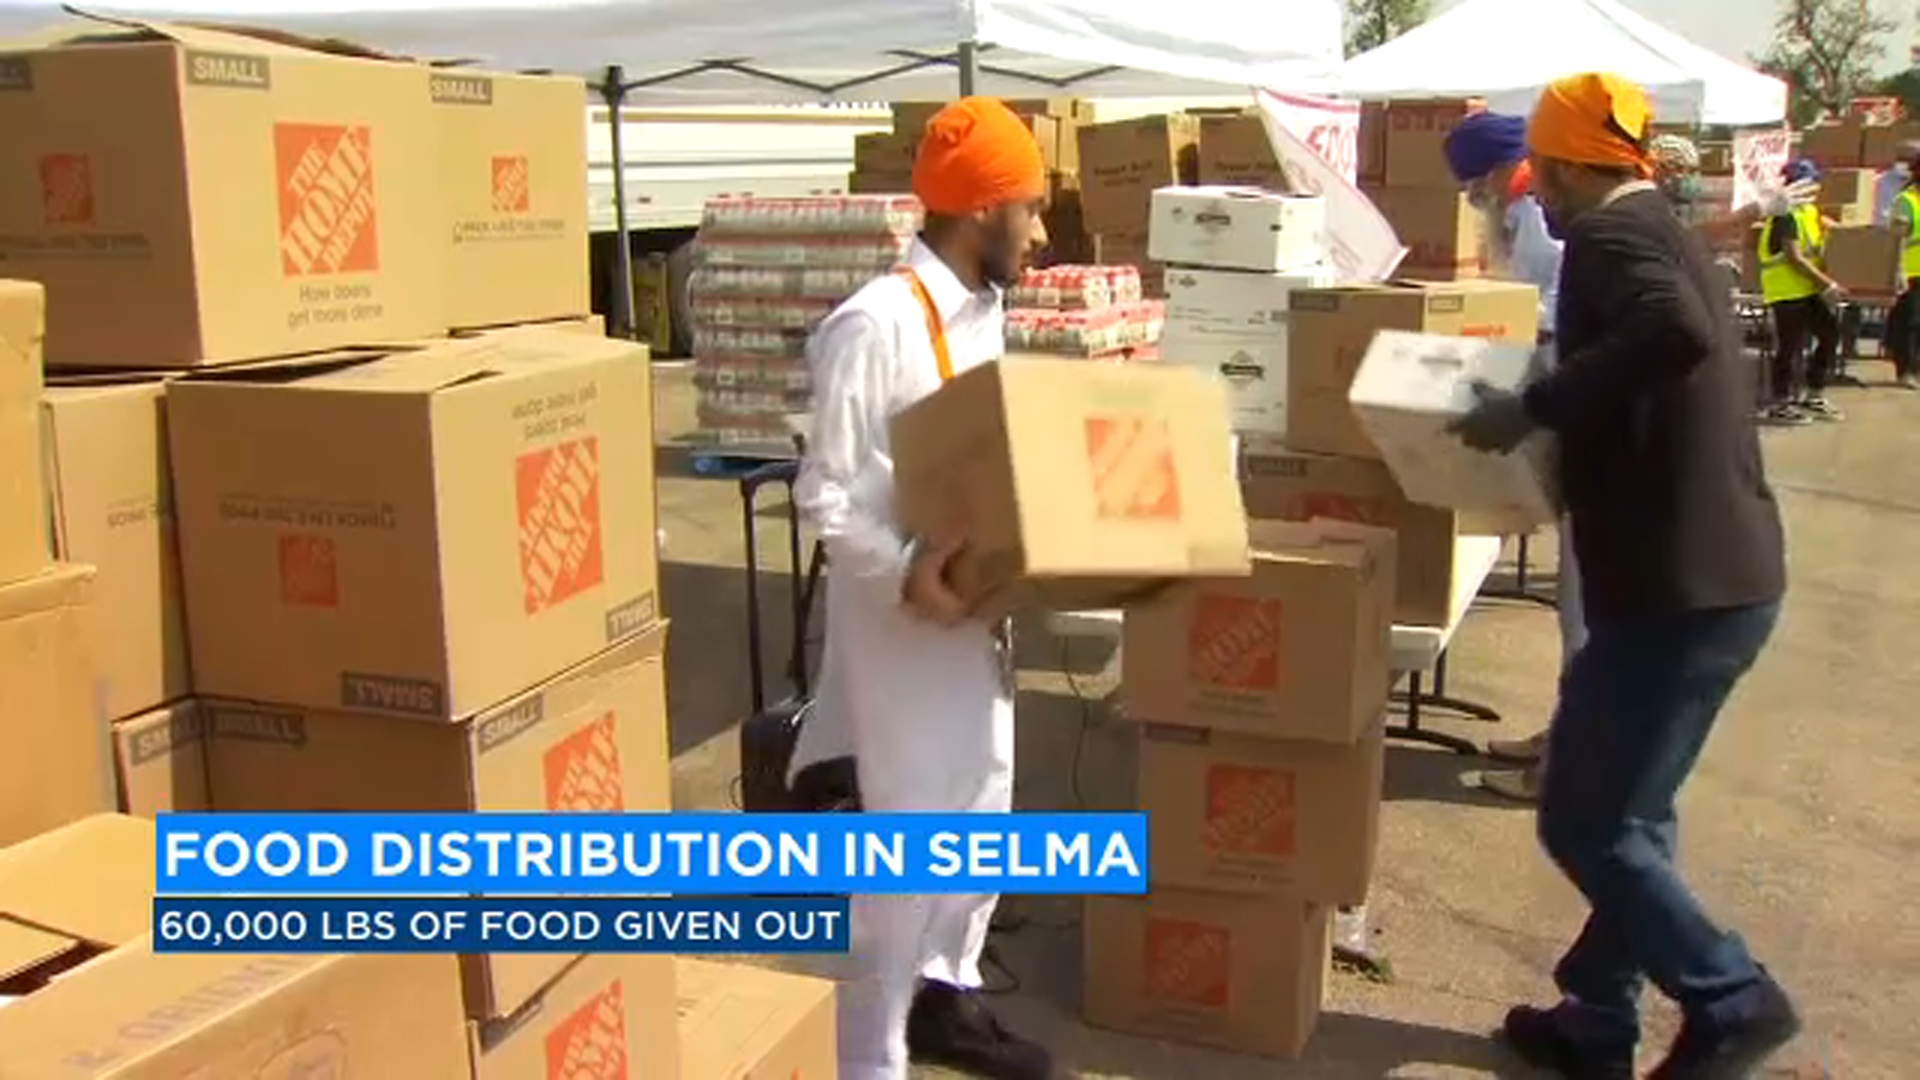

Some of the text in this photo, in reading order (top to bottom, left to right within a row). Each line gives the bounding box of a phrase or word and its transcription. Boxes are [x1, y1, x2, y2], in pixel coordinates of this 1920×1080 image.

[193, 57, 265, 84] SMALL
[431, 79, 488, 101] SMALL
[288, 140, 329, 197] THE
[279, 124, 371, 276] HOME
[322, 185, 374, 276] DEPOT
[528, 440, 598, 608] HOME
[610, 597, 653, 632] SMALL
[354, 680, 434, 710] SMALL
[482, 697, 540, 745] SMALL
